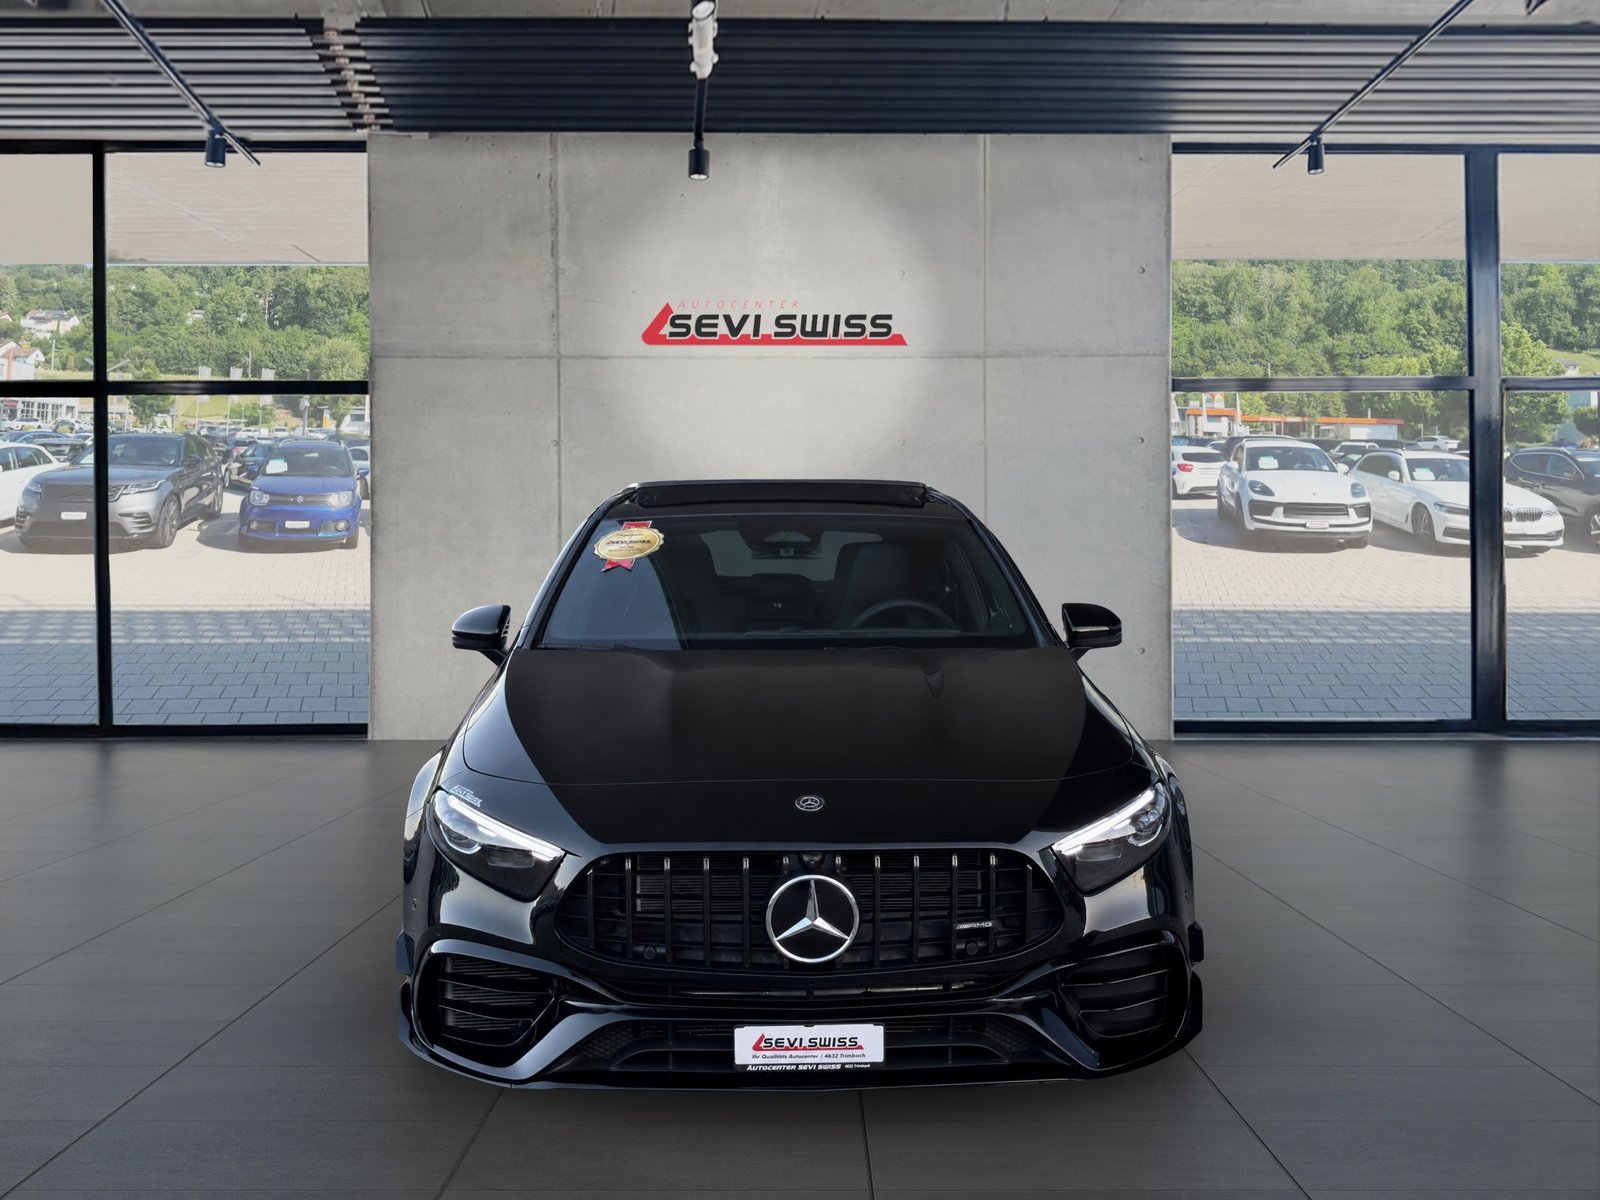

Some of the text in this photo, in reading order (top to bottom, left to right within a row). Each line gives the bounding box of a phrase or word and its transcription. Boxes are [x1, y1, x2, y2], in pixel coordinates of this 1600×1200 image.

[678, 299, 800, 310] AUTOCENTER
[668, 313, 893, 339] SEVI SWISS
[763, 1036, 858, 1048] SEVI SWISS
